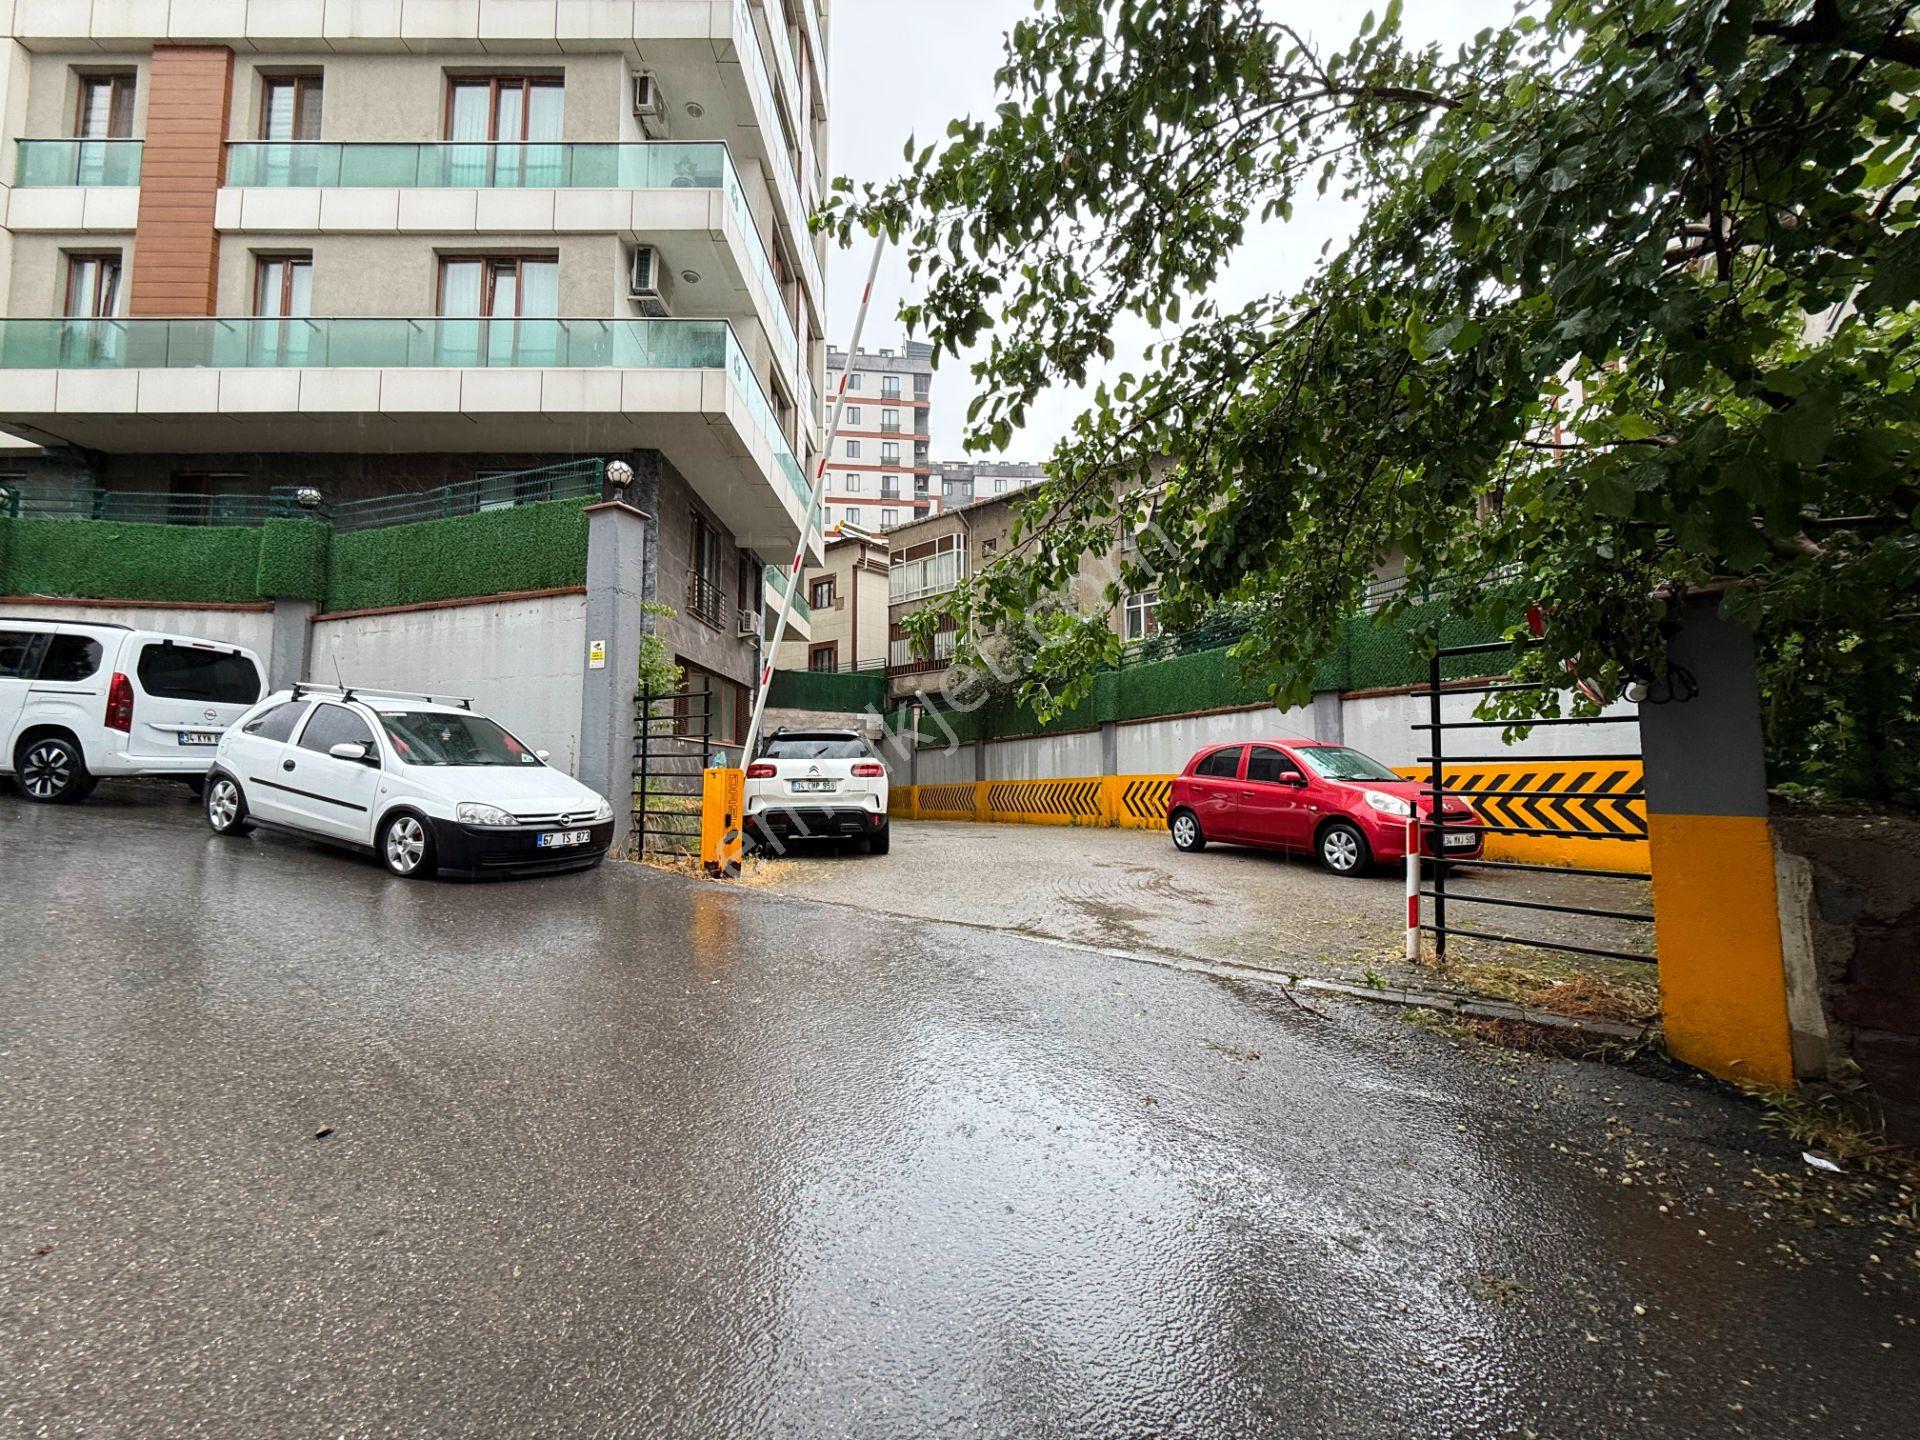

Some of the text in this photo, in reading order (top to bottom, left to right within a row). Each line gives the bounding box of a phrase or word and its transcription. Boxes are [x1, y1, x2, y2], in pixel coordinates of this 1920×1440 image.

[797, 782, 805, 790] 34
[543, 831, 590, 846] 67 TS 873
